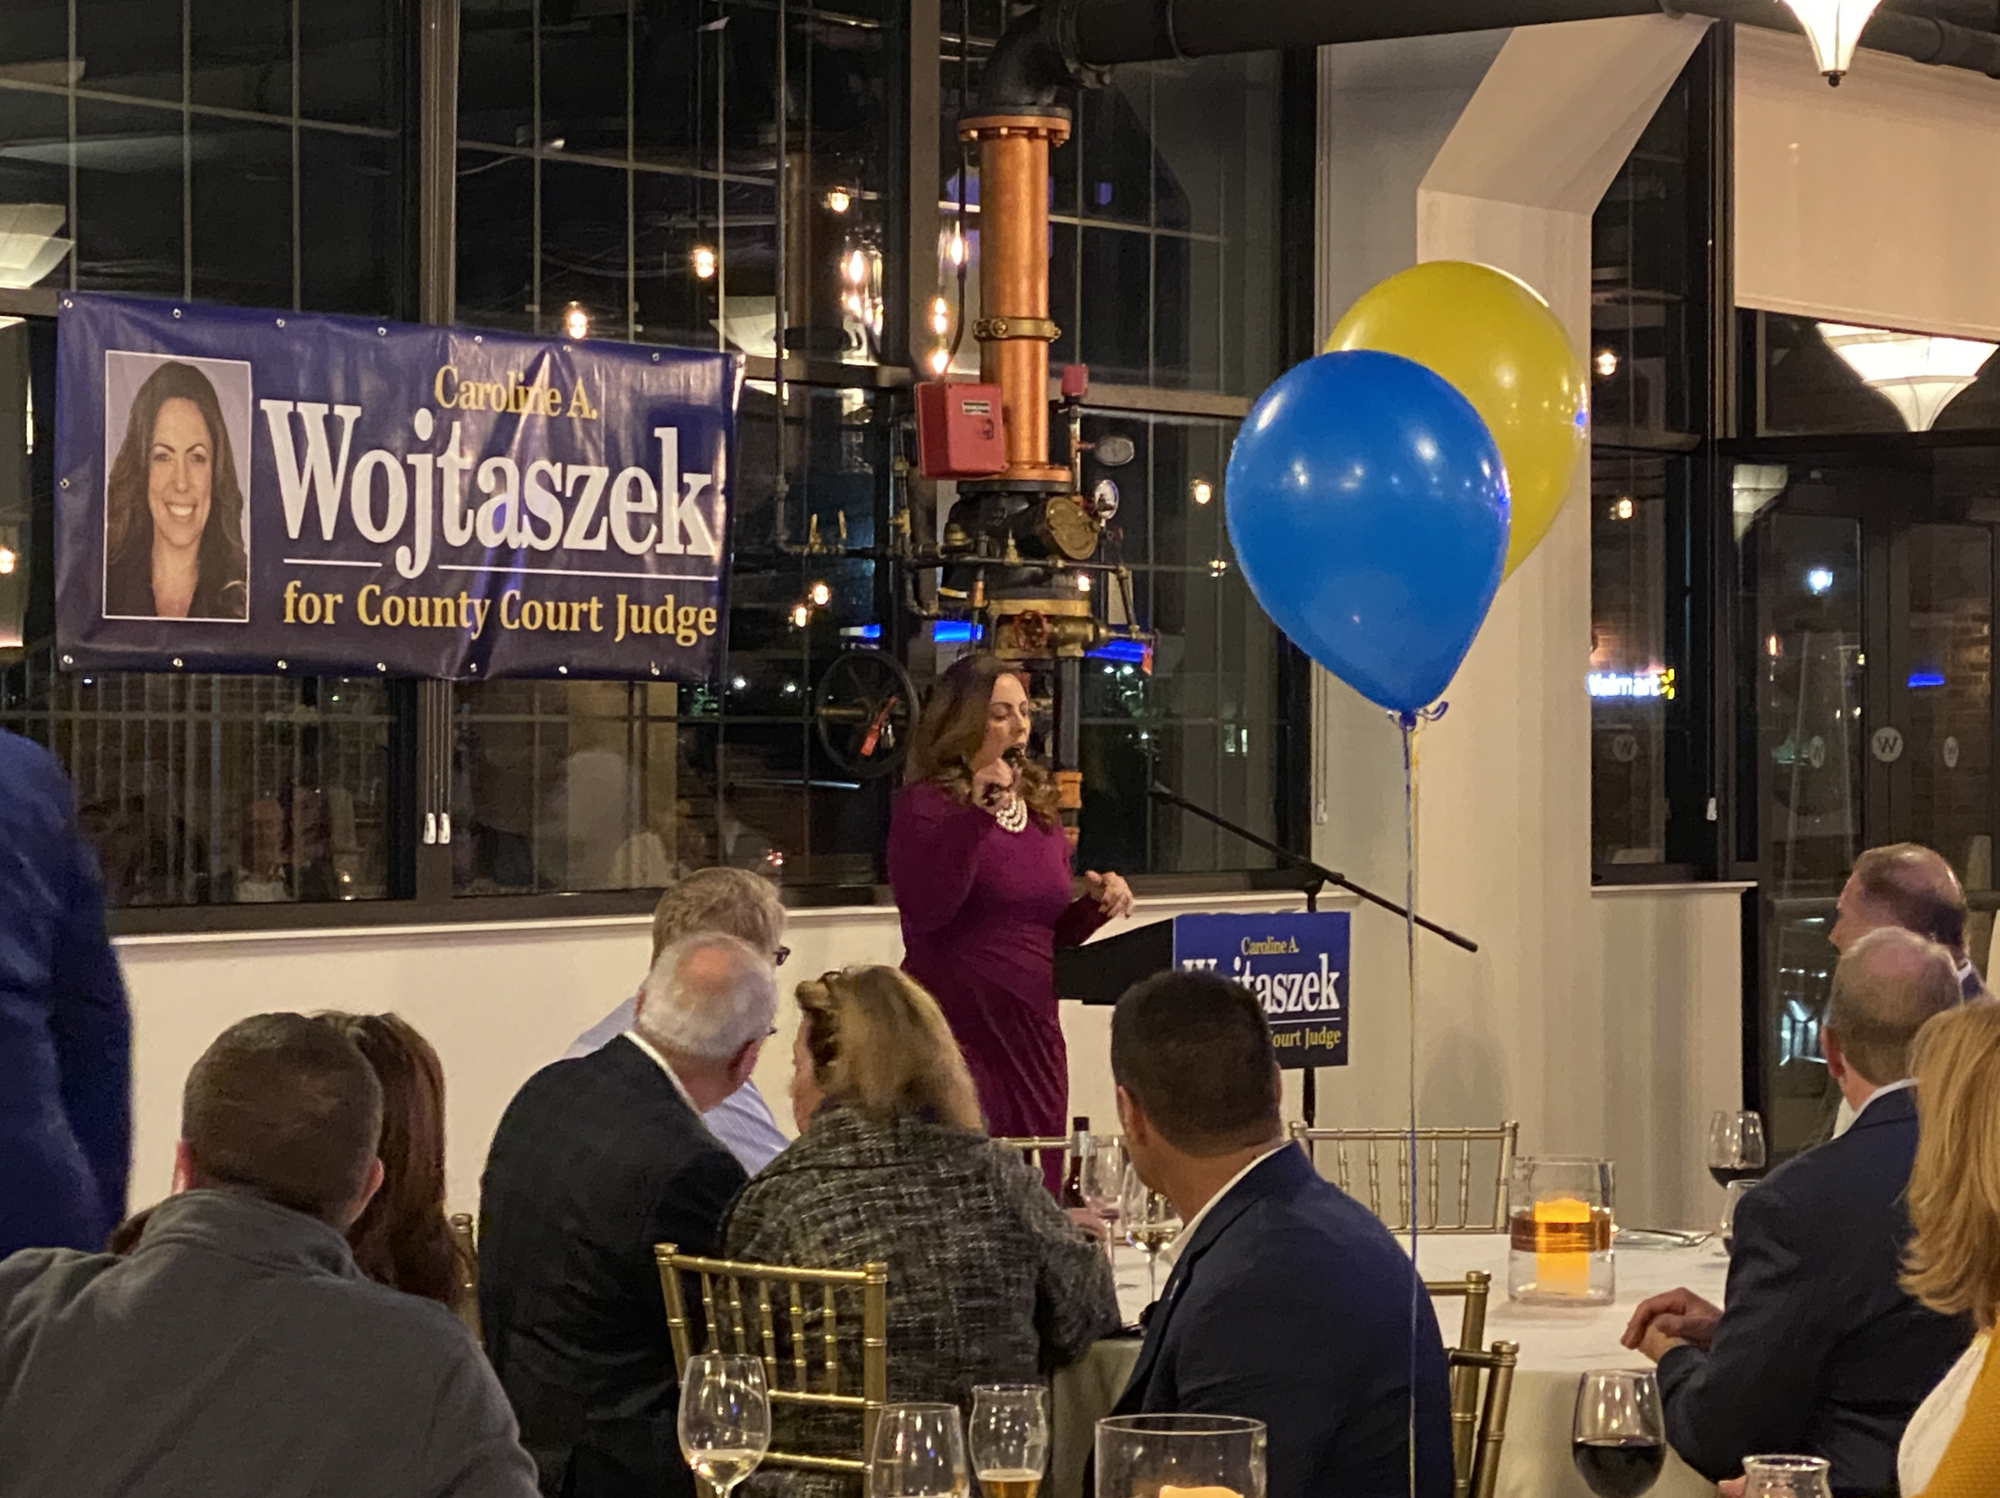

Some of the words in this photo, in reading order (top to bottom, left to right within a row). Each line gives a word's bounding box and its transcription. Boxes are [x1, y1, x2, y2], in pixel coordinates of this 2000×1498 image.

[434, 365, 562, 417] Caroline
[566, 376, 598, 420] A.
[260, 399, 717, 579] Wojtaszek
[284, 580, 344, 624] for
[357, 584, 491, 640] County
[500, 589, 604, 632] Court
[614, 594, 718, 647] Judge
[1876, 735, 1899, 754] W
[1241, 936, 1287, 955] Caroline
[1183, 953, 1340, 1014] taszek
[1271, 1029, 1301, 1047] ourt
[1305, 1027, 1341, 1049] Judge
